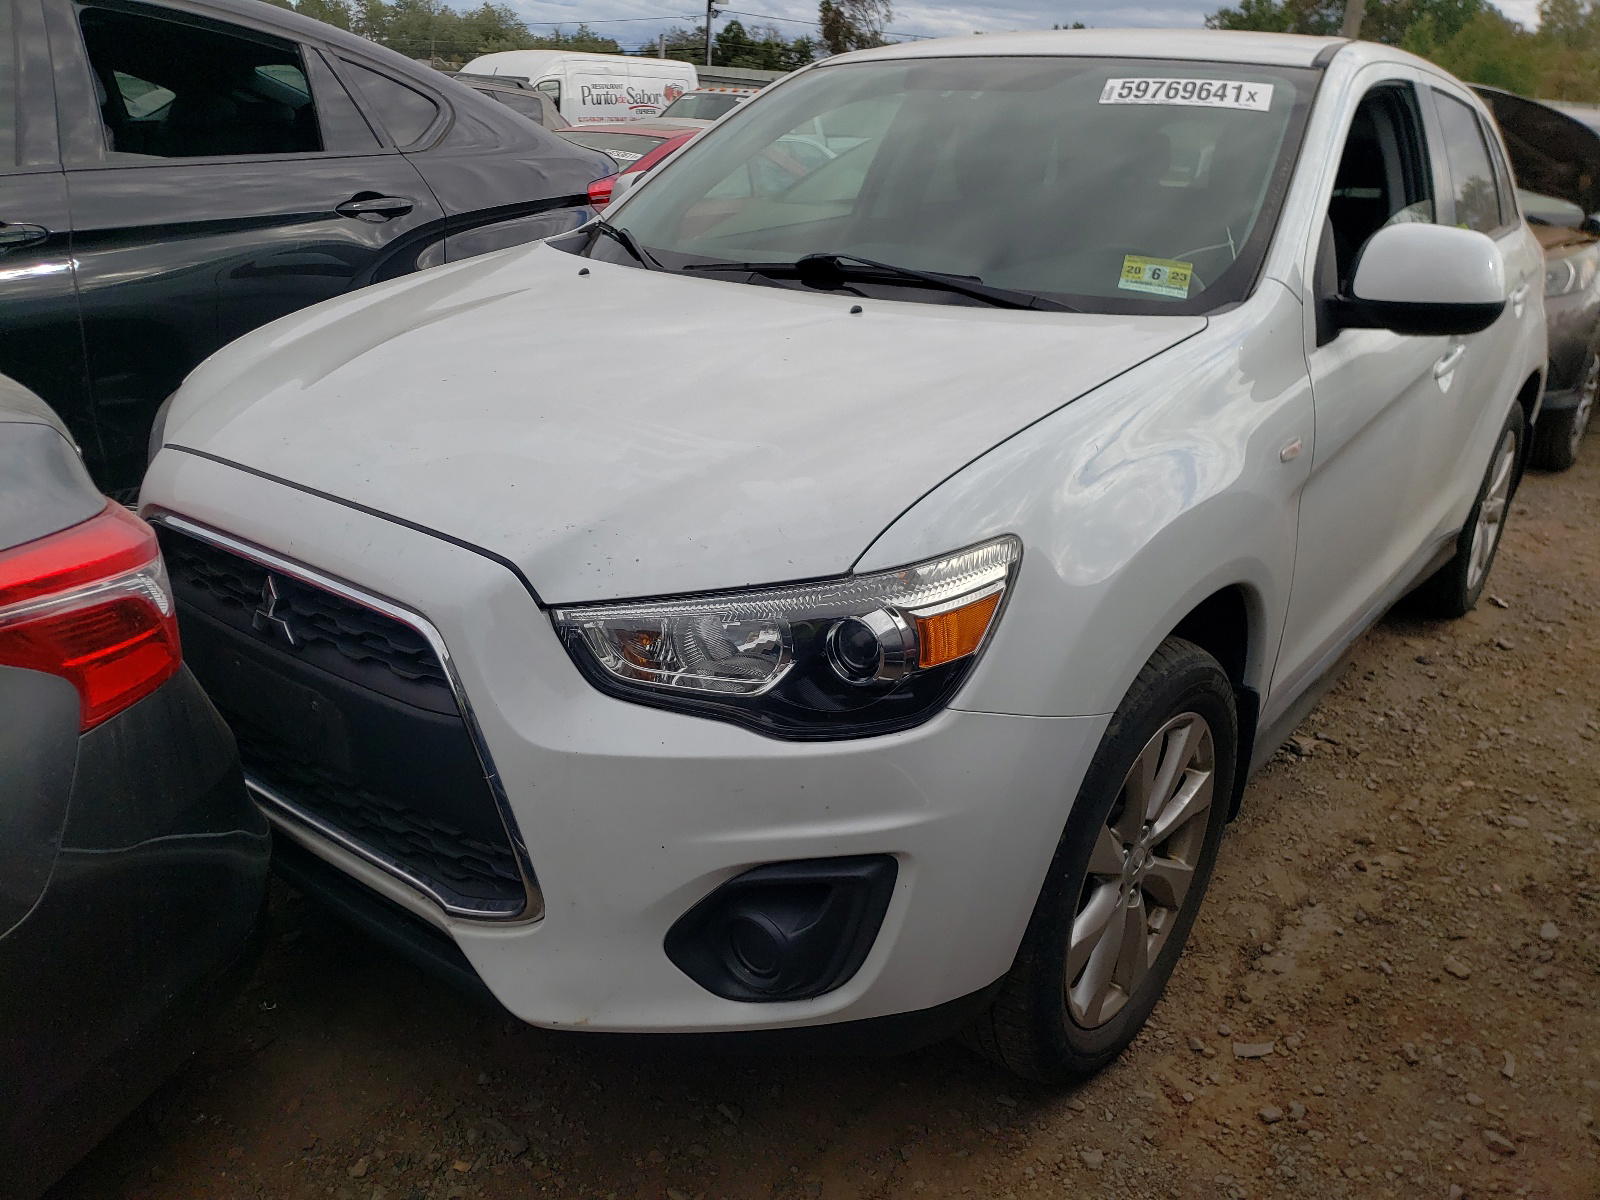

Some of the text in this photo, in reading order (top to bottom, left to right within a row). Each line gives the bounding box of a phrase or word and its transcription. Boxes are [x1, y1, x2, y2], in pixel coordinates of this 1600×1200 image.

[581, 85, 618, 105] Punto
[626, 87, 661, 104] Sabor
[1127, 265, 1141, 274] 20
[1151, 268, 1161, 280] 6
[1171, 271, 1187, 281] 23
